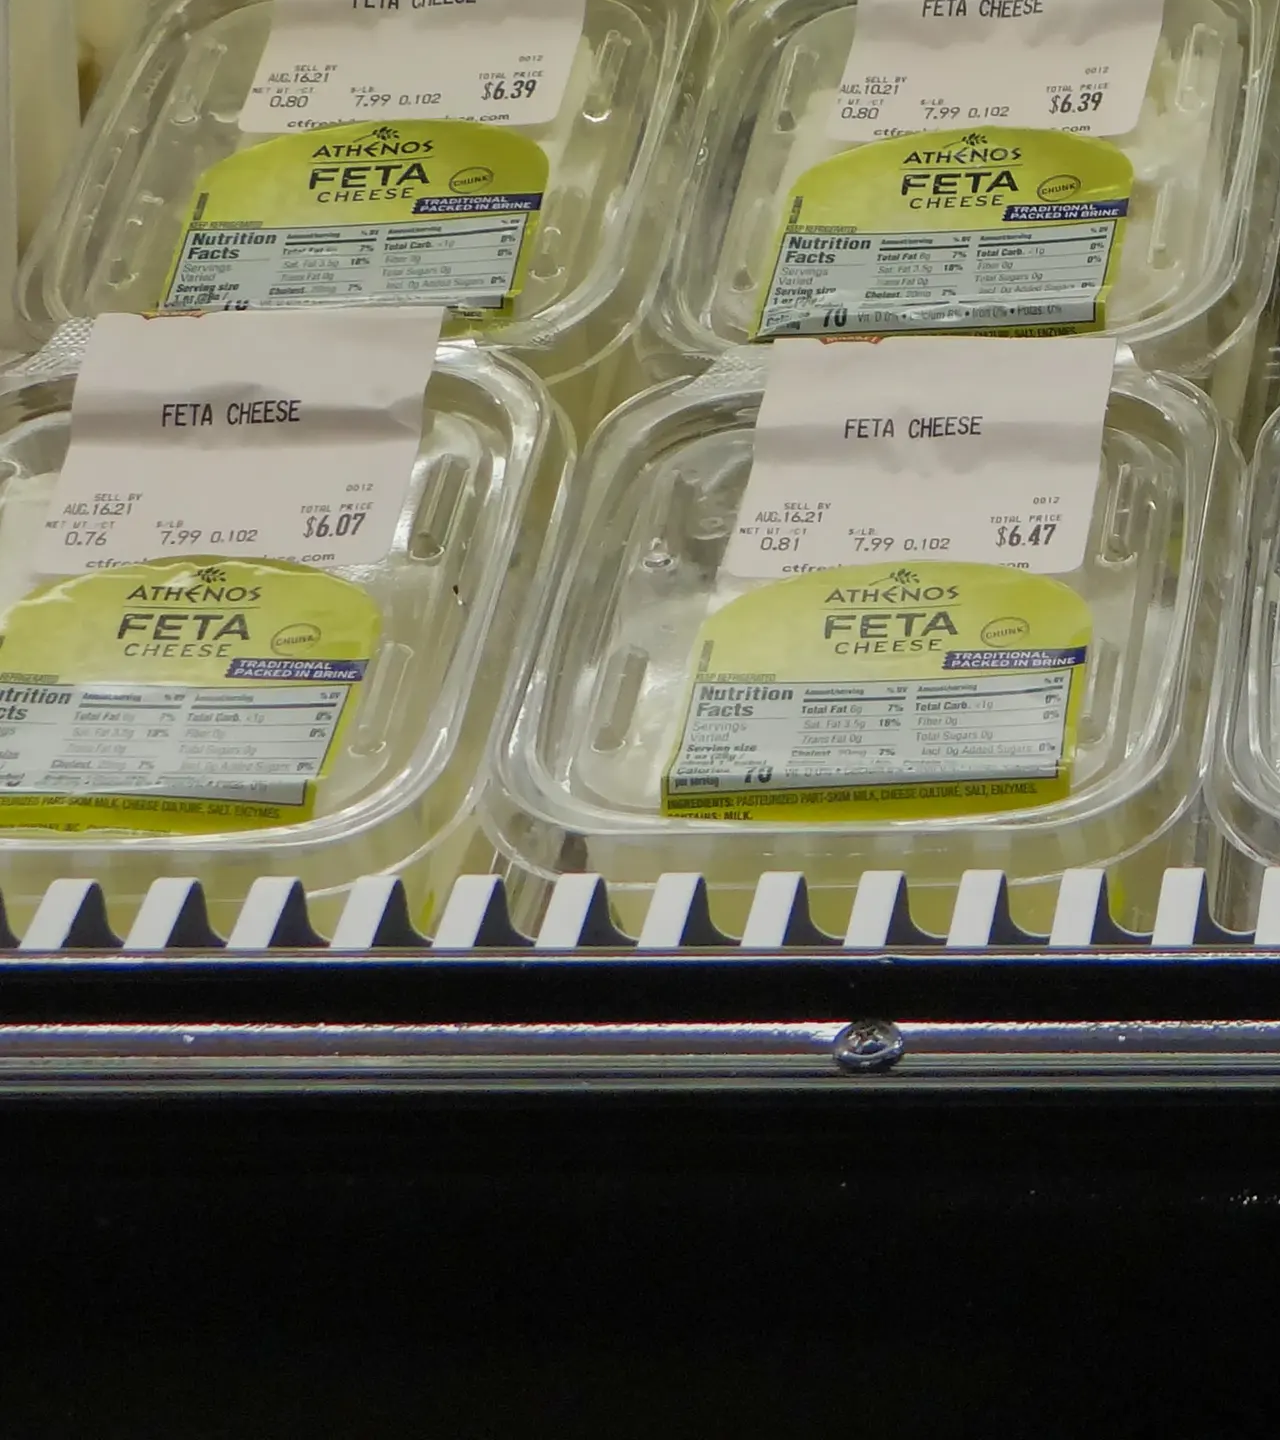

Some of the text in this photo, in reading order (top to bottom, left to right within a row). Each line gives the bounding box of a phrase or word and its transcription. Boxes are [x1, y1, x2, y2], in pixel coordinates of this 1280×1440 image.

[481, 79, 537, 101] $6.39
[1048, 92, 1102, 114] $6.39
[312, 139, 434, 159] ATHENOS
[903, 147, 1022, 164] ATHENOS
[307, 163, 430, 190] FETA
[900, 171, 1019, 196] FETA
[316, 187, 414, 204] CHEESE
[1040, 182, 1077, 195] CHUNK
[909, 194, 1004, 210] CHEESE
[1012, 204, 1096, 215] TRADITIONAL
[1010, 208, 1120, 220] PACKED IN BRINE
[162, 400, 302, 427] FETA CHEESE
[844, 416, 983, 439] FETA CHEESE
[303, 513, 366, 538] $6.07
[996, 524, 1057, 547] $6.47
[854, 537, 951, 552] 7.99 0.102
[126, 584, 262, 603] ATHENOS
[824, 586, 959, 603] ATHENOS
[117, 612, 251, 642] FETA
[823, 610, 959, 640] FETA
[834, 638, 943, 654] CHEESE
